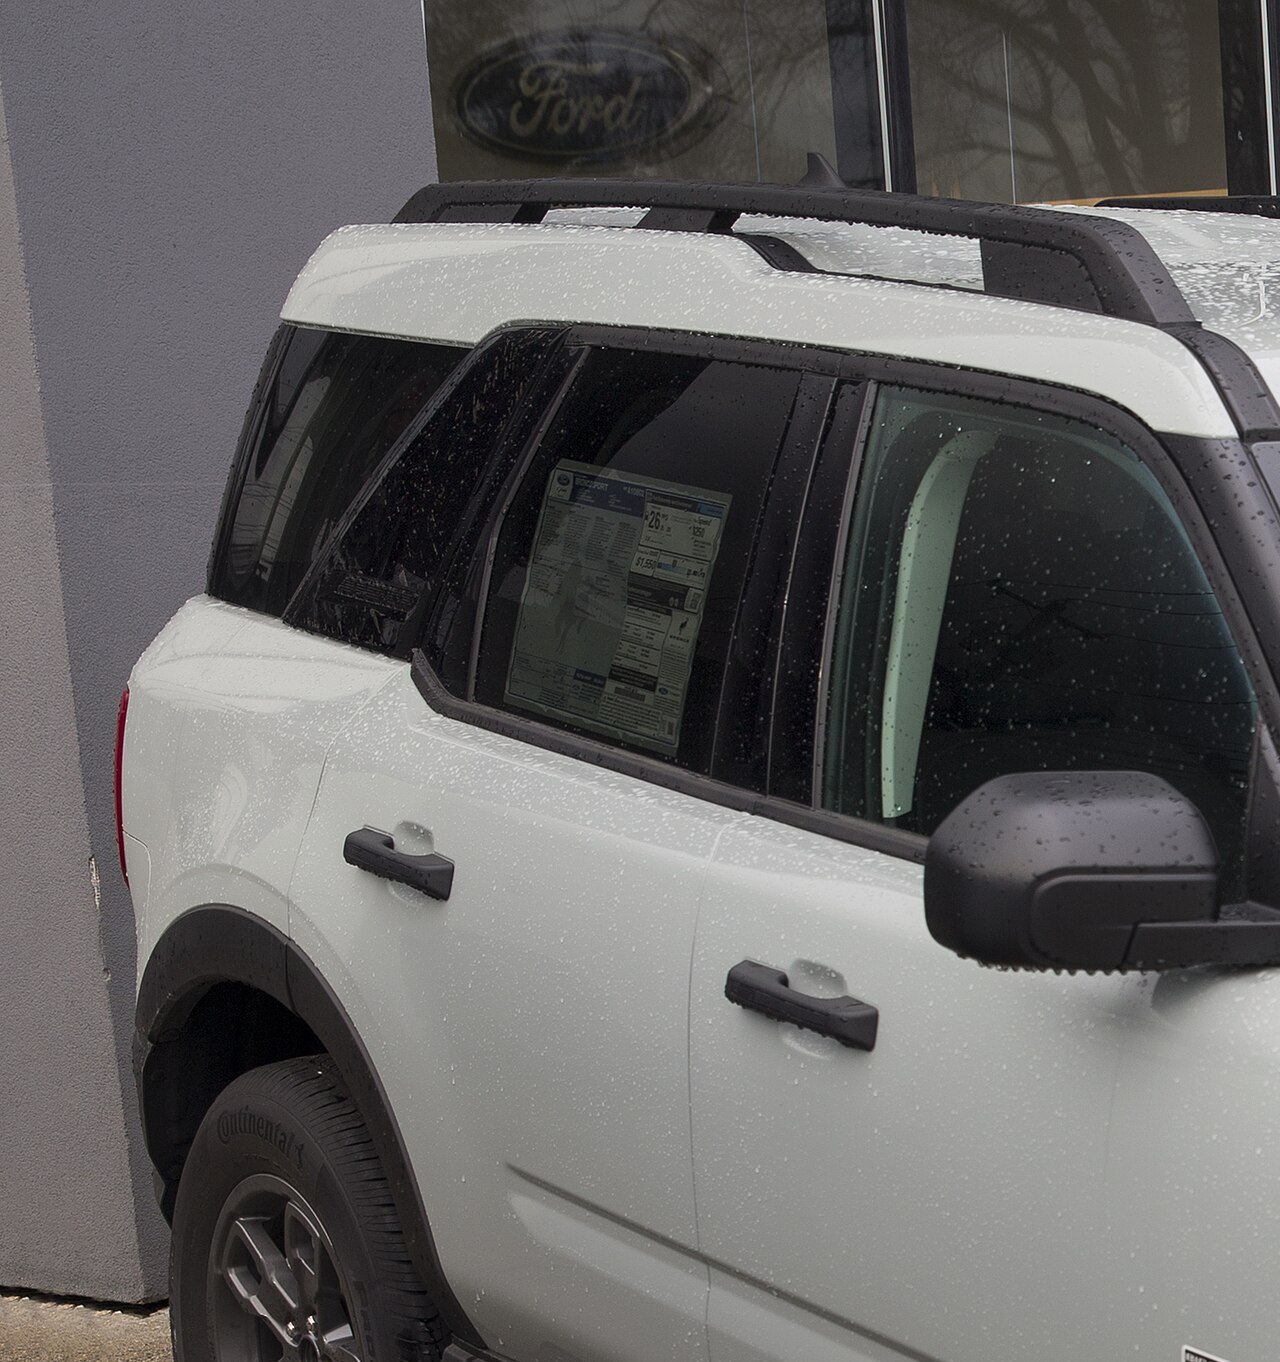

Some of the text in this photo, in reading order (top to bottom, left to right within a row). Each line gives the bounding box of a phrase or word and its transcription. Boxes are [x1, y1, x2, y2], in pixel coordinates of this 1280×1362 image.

[509, 60, 643, 137] Ford
[647, 510, 662, 531] 26
[635, 557, 657, 571] $1,550
[217, 1105, 295, 1158] Continental
